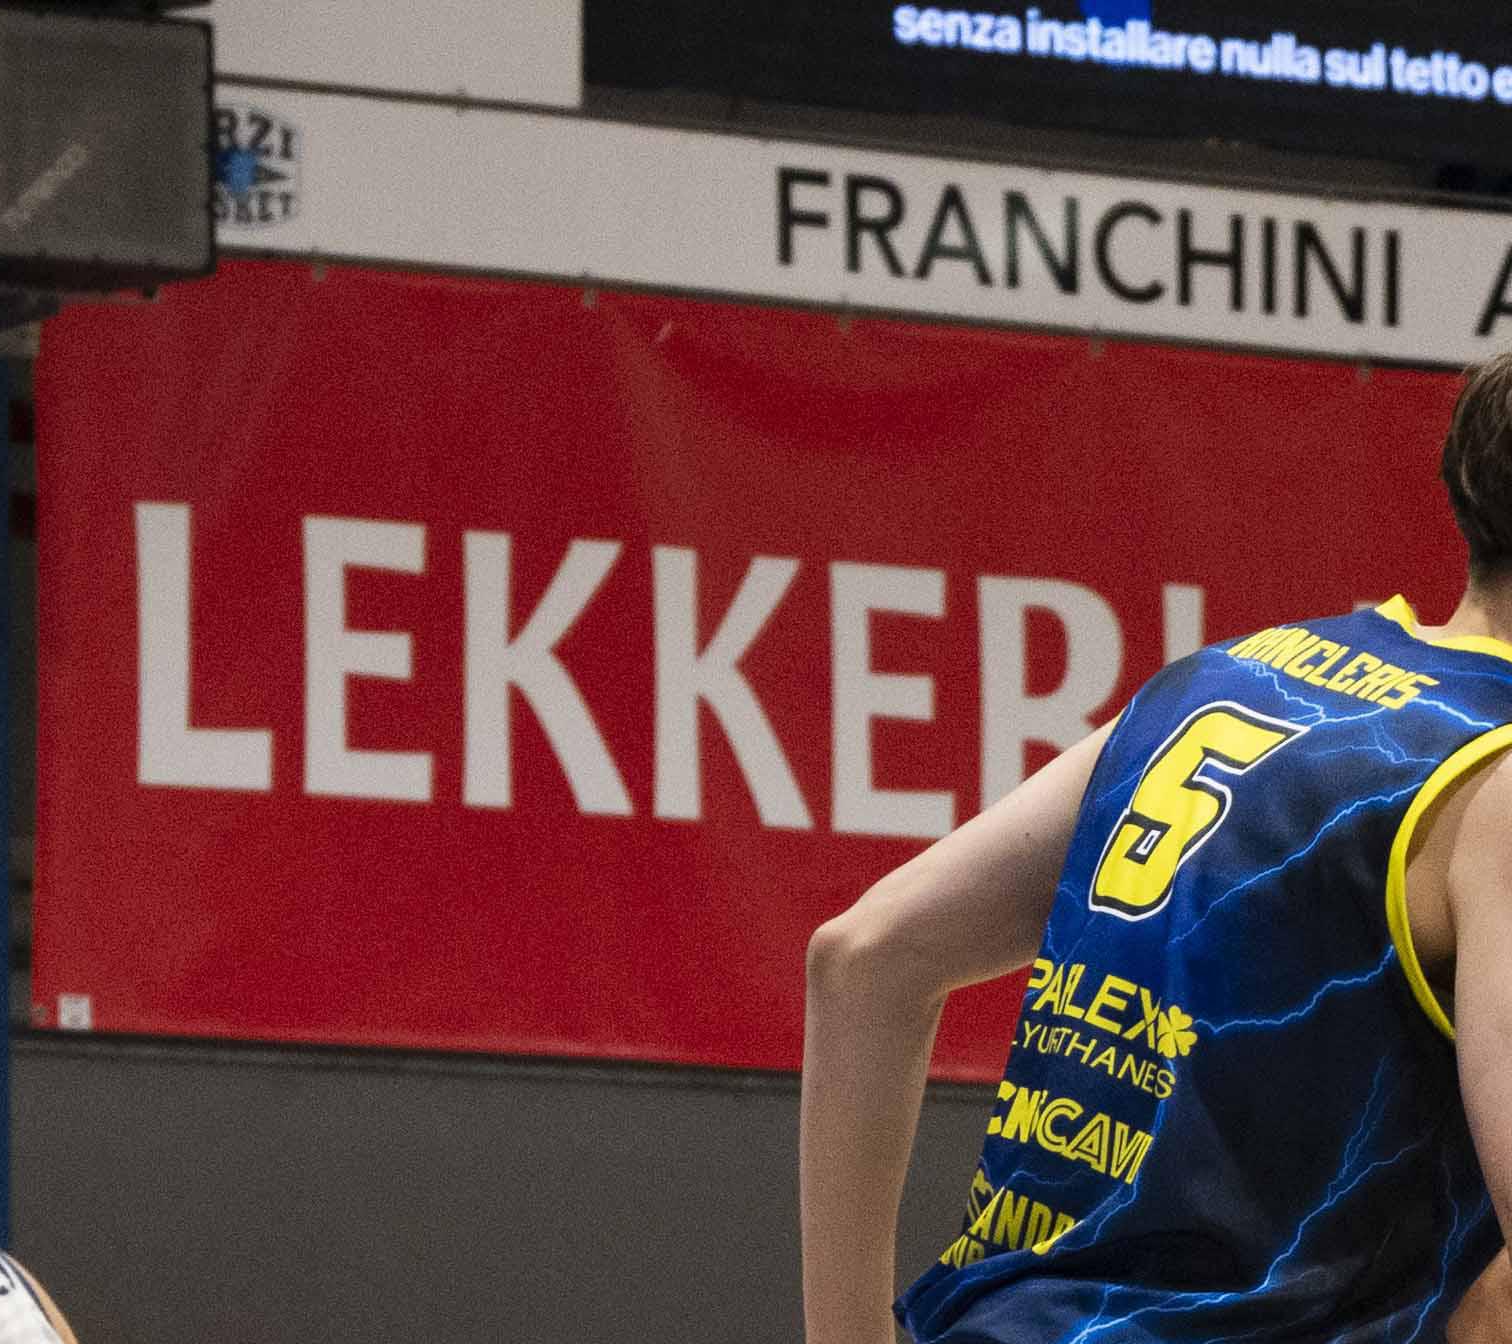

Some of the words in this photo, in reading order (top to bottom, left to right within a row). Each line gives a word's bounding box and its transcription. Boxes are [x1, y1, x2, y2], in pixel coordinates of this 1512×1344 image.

[894, 8, 1020, 52] senza
[1026, 18, 1214, 74] installare
[1221, 36, 1319, 84] nulla
[1325, 42, 1386, 90] sul
[1390, 48, 1488, 98] tetto
[775, 164, 1400, 328] FRANCHINI
[1088, 700, 1310, 922] 5
